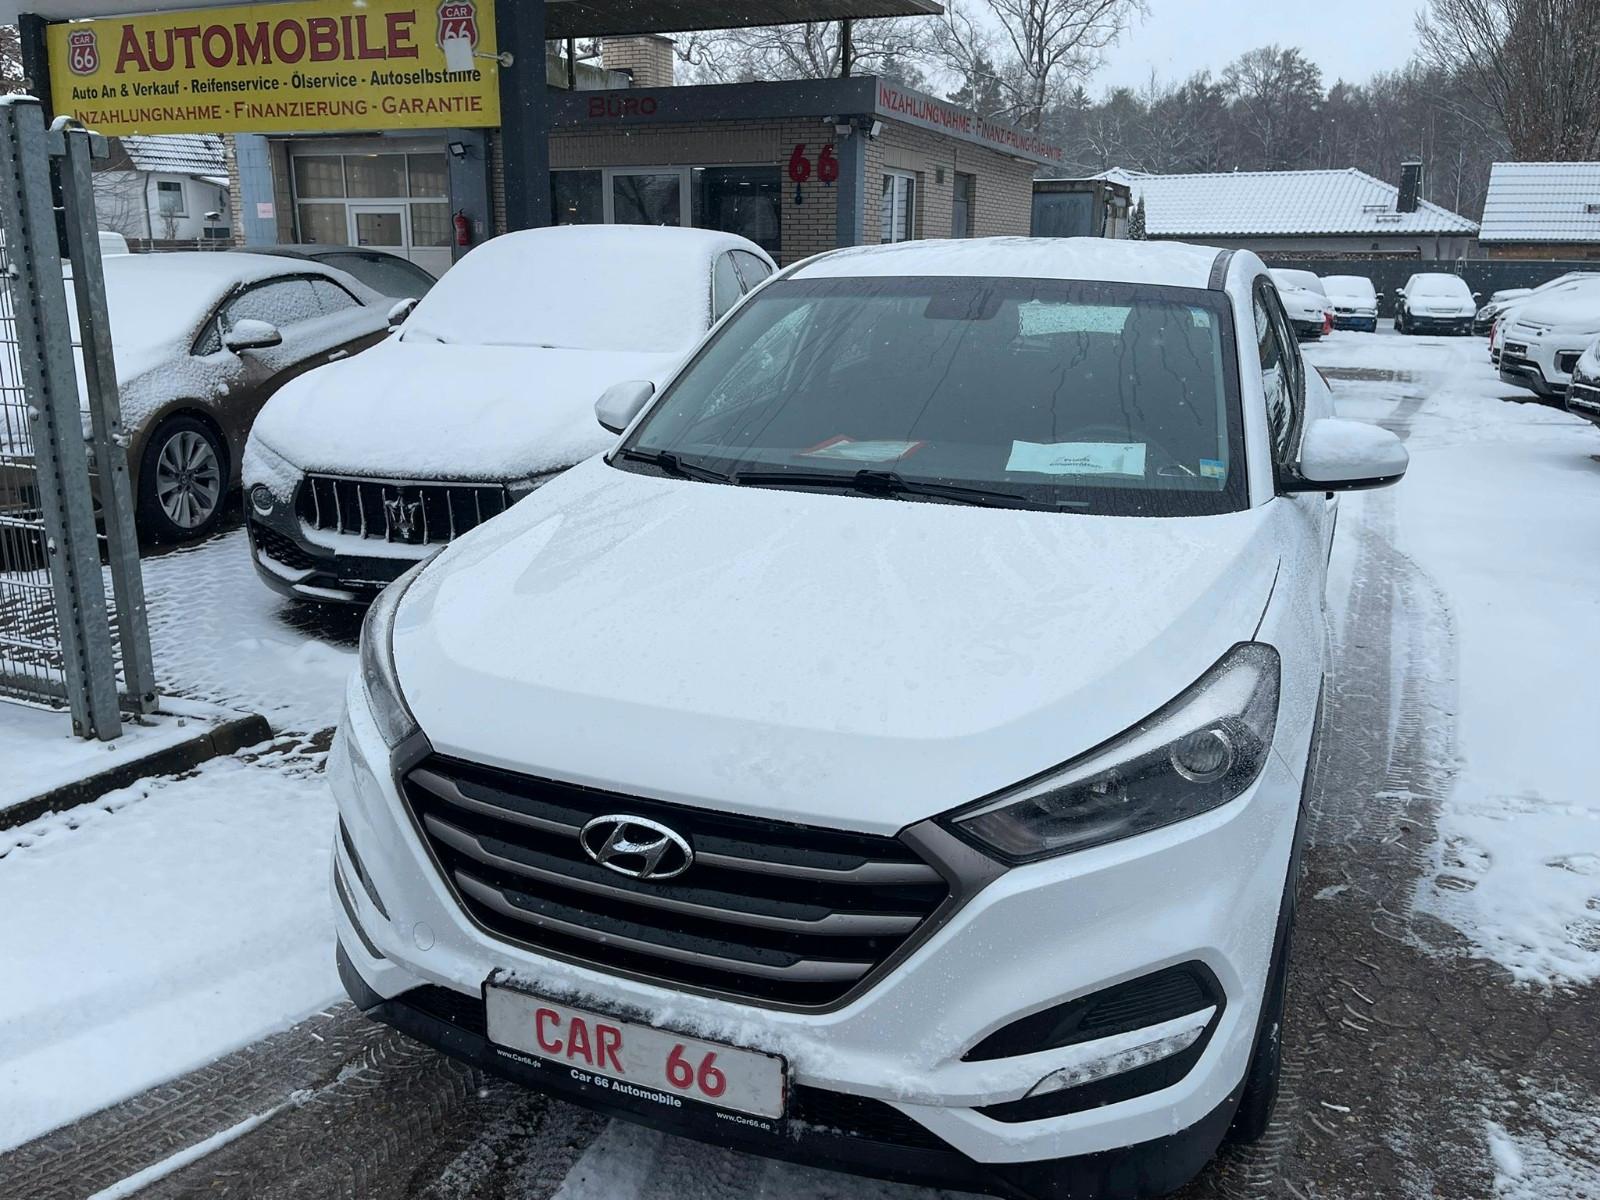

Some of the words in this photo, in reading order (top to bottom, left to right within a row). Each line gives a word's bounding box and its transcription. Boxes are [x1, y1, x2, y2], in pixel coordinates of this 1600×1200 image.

[446, 8, 468, 17] CAR
[73, 35, 90, 45] CAR
[115, 9, 419, 73] AUTOMOBILE
[74, 48, 94, 70] 66
[72, 86, 98, 100] Auto
[102, 84, 116, 98] An
[121, 84, 129, 97] &
[133, 82, 180, 97] Verkauf
[192, 76, 279, 94] Reifenservice
[291, 71, 357, 89] Ölservice
[74, 105, 221, 125] INZAHLUNGNAHME
[234, 100, 368, 120] FINANZIERUNG
[382, 96, 483, 114] GARANTIE
[589, 95, 657, 118] BÜRO
[879, 82, 970, 134] INZAHLUNGNAHME
[790, 144, 839, 183] 66
[536, 1007, 625, 1074] CAR
[665, 1043, 727, 1098] 66
[570, 1069, 592, 1083] Car
[594, 1076, 609, 1088] 66
[612, 1081, 682, 1108] Automobile
[716, 1112, 771, 1130] www.Car66.de
